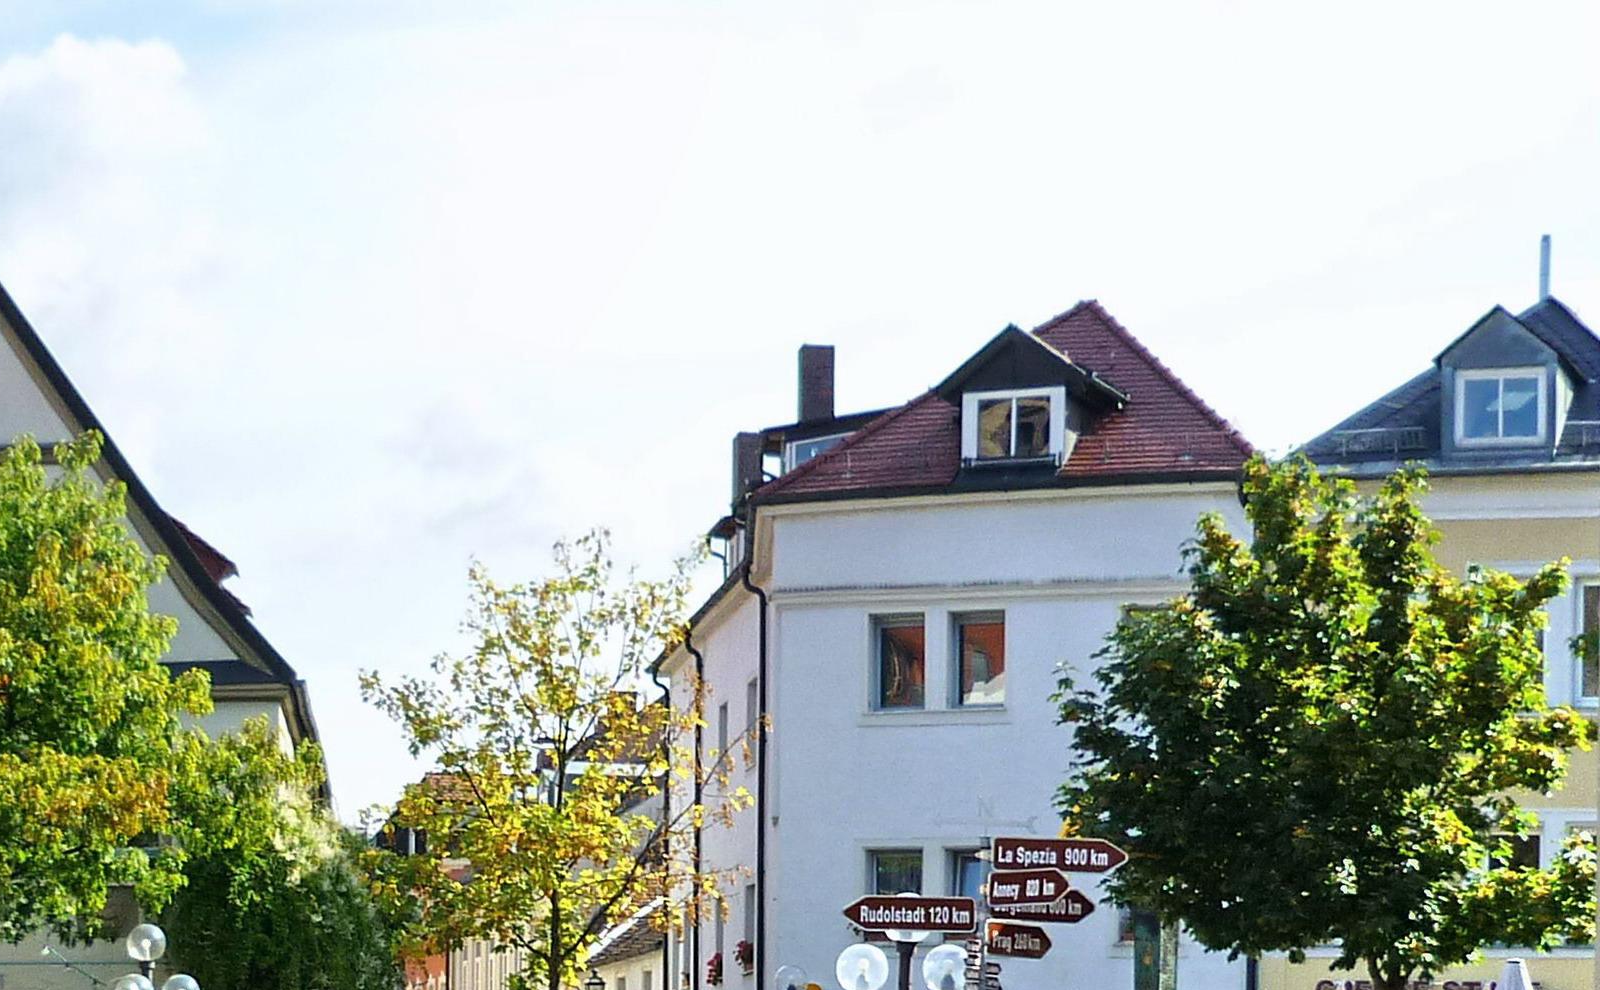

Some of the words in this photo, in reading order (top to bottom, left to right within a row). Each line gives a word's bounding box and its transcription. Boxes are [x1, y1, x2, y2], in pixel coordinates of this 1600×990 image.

[998, 847, 1013, 862] La
[1016, 848, 1057, 865] Spezia
[1064, 848, 1087, 865] 900
[1090, 848, 1109, 866] km
[992, 881, 1020, 900] Annecy
[860, 907, 926, 924] Rudolstadt
[928, 908, 949, 924] 120
[952, 907, 971, 924] km
